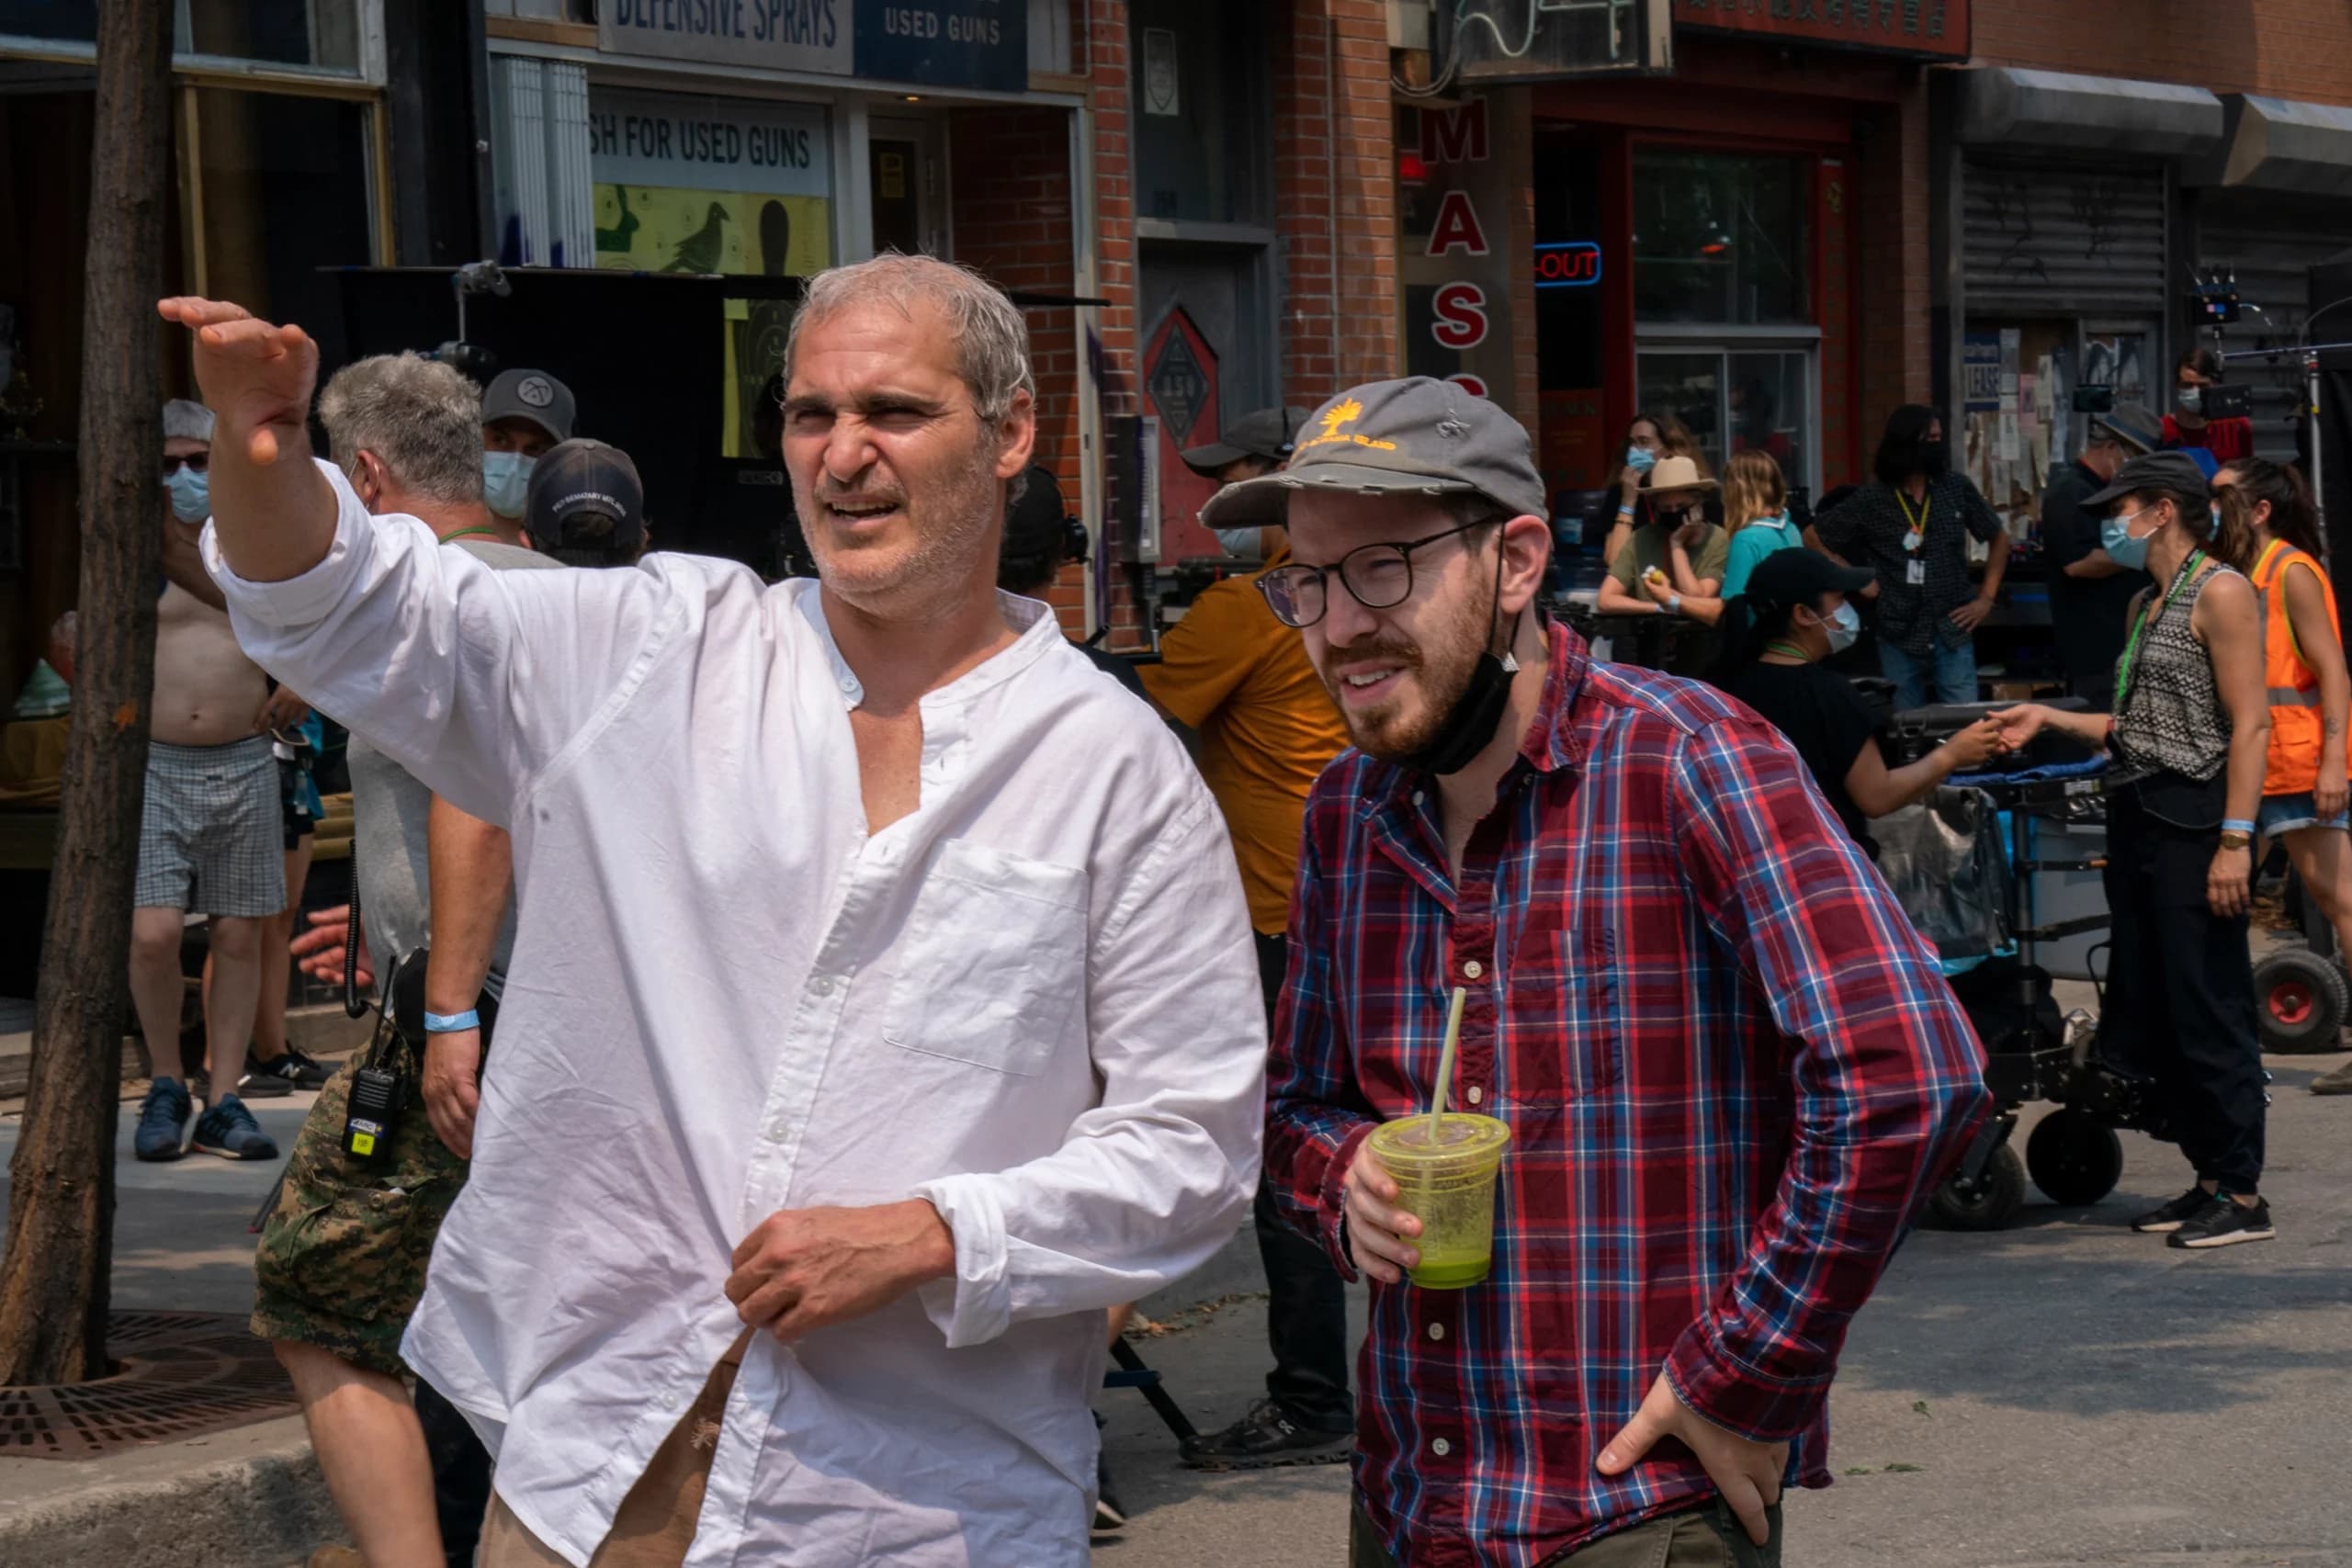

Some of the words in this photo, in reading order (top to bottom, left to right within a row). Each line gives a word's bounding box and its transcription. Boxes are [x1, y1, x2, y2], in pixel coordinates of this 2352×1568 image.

[617, 0, 745, 39] DEFENSIVE
[752, 0, 836, 48] SPRAYS
[885, 6, 939, 39] USED
[947, 14, 1001, 46] GUNS
[625, 115, 673, 161] FOR
[679, 119, 741, 164] USED
[748, 125, 810, 169] GUNS
[1418, 95, 1490, 398] MAS
